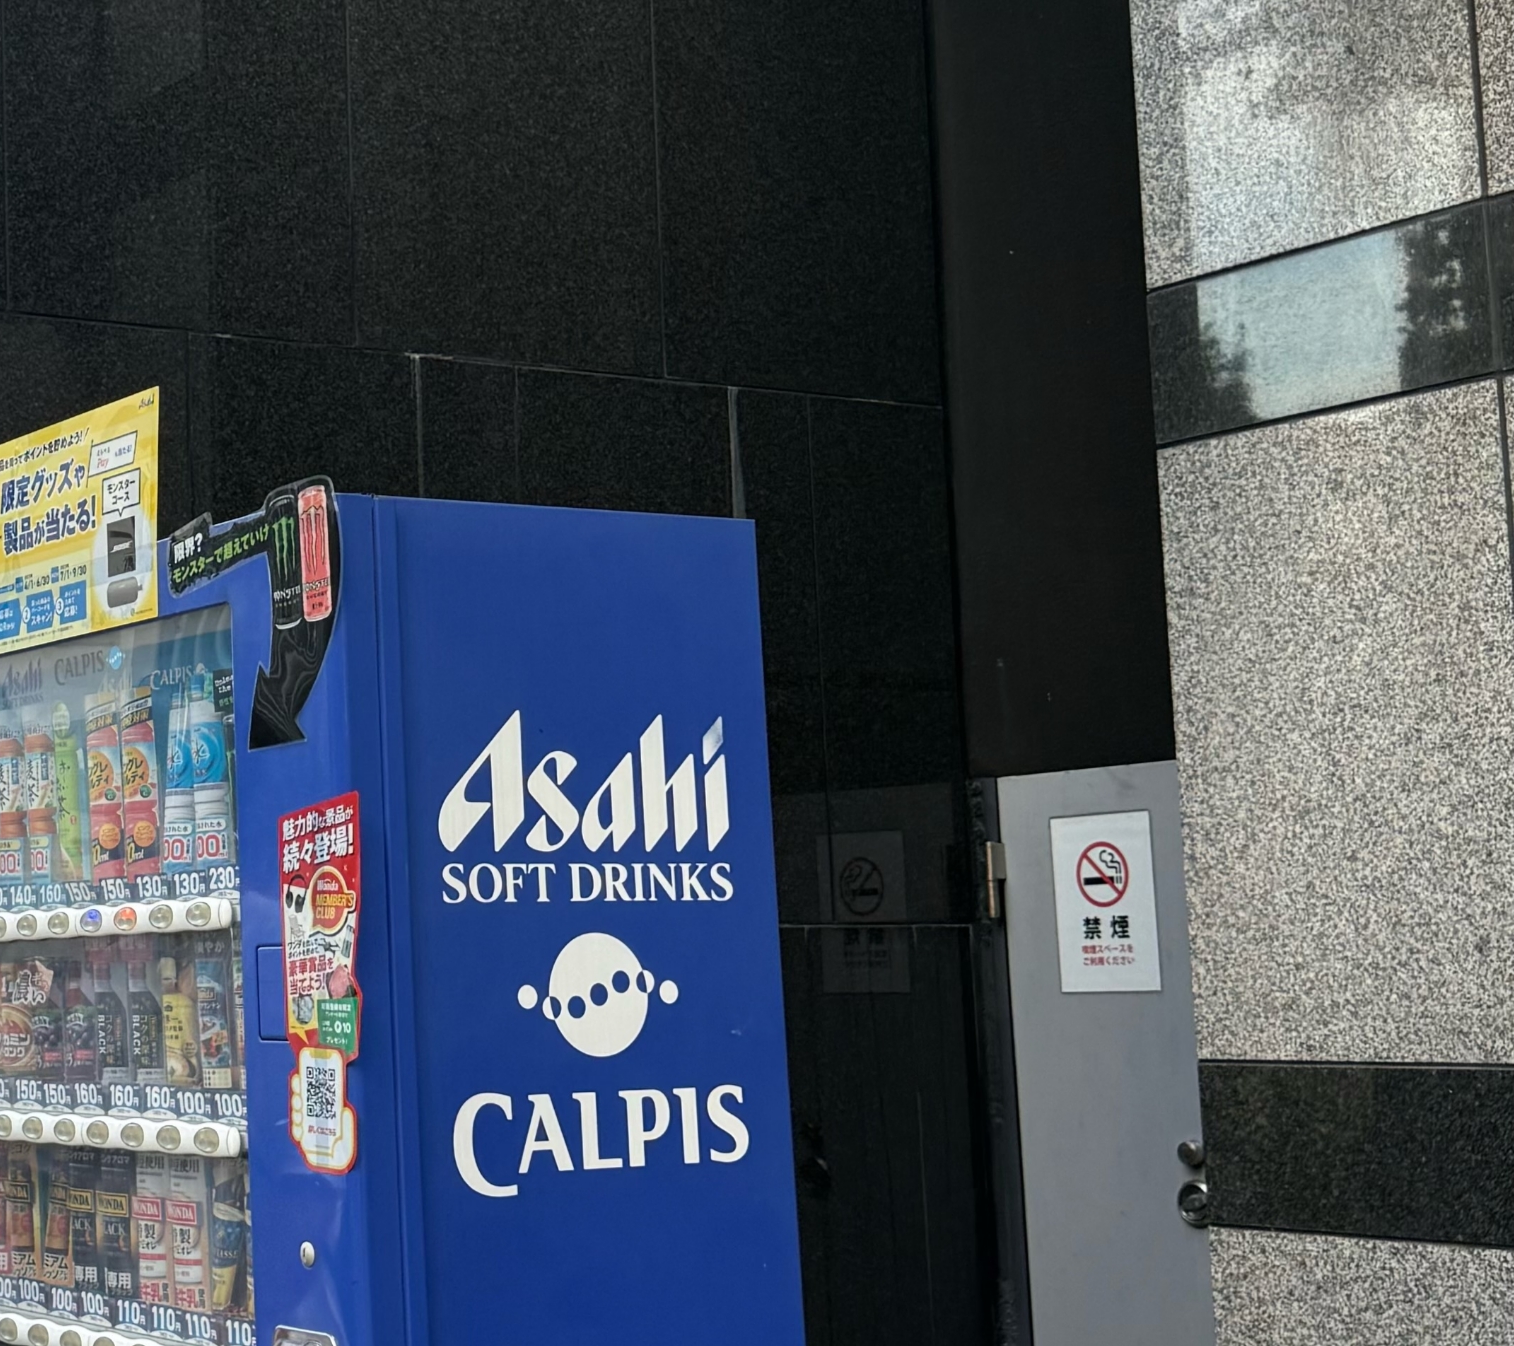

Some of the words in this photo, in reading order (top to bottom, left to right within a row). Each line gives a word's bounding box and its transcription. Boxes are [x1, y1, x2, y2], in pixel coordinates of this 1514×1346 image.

[1, 458, 85, 515] 限定グッズや
[107, 479, 136, 495] モンスター
[111, 492, 130, 505] コース
[3, 495, 96, 555] 製品が当たる!
[172, 524, 270, 583] モンスターで超えていけ
[173, 532, 203, 564] 限界?
[54, 650, 104, 686] CALPIS
[151, 665, 193, 690] CALPIS
[438, 709, 729, 852] Asahi
[283, 805, 353, 841] 魅力的な景品が
[283, 823, 354, 873] 続々登場!
[10, 884, 36, 906] 140円
[101, 878, 131, 900] 150円
[136, 874, 167, 897] 130円
[173, 872, 205, 896] 130円
[441, 862, 556, 904] SOFT
[570, 862, 733, 903] DRINKS
[316, 894, 353, 907] MEMBER'S
[316, 907, 336, 919] CLUB
[1083, 915, 1130, 940] 禁煙
[289, 954, 333, 976] 豪華賞品を
[290, 971, 325, 995] 当てよう!
[98, 1015, 106, 1055] BLACK
[16, 1079, 41, 1100] 150円
[44, 1083, 71, 1104] 150円
[75, 1083, 102, 1104] 160円
[110, 1084, 139, 1106] 160円
[146, 1086, 175, 1108] 160円
[178, 1091, 211, 1115] 100円
[453, 1084, 749, 1197] CALPIS
[74, 1266, 97, 1283] 専用
[108, 1271, 131, 1288] 専用
[19, 1278, 45, 1302] 100円
[52, 1287, 77, 1311] 100円
[82, 1290, 109, 1315] 100円
[117, 1299, 146, 1324] 110円
[152, 1305, 181, 1332] 110円
[186, 1312, 217, 1340] 110円
